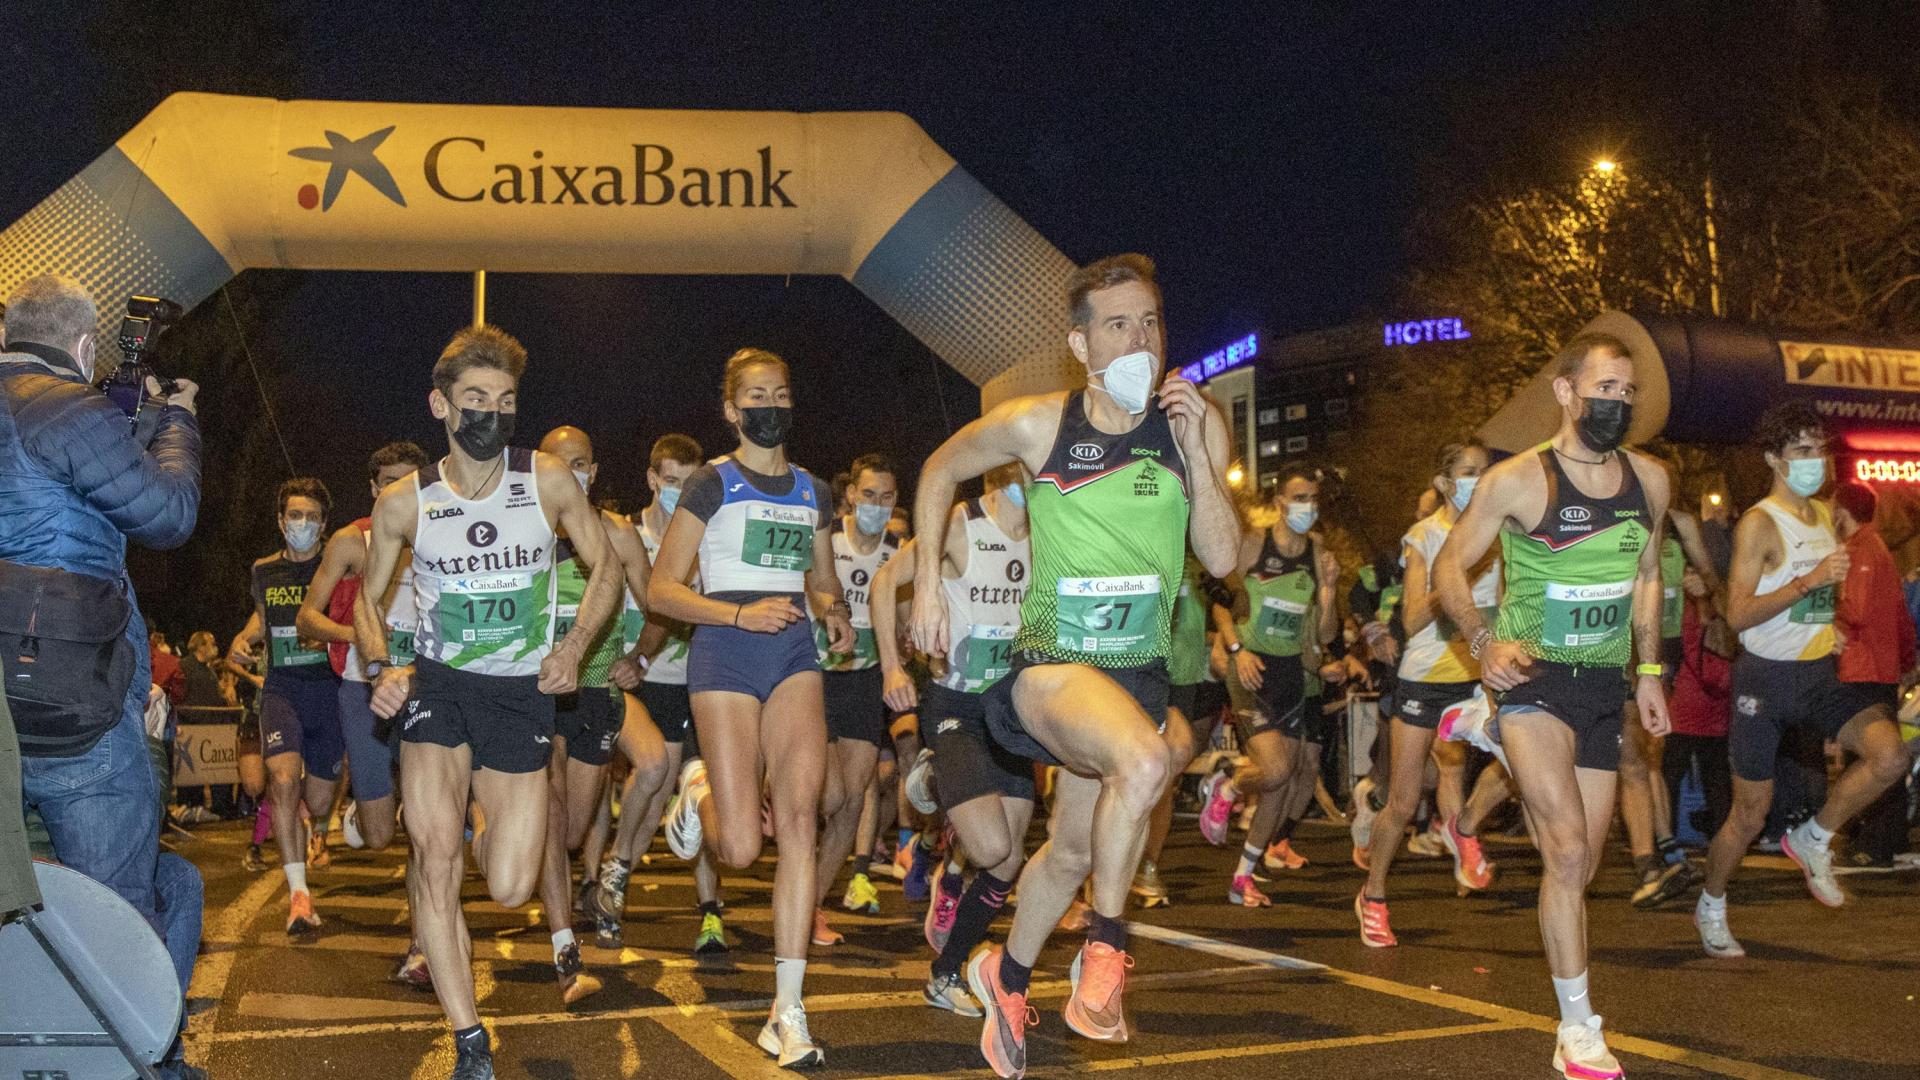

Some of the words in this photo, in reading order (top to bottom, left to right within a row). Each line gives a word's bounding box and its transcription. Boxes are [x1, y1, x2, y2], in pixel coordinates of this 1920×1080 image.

[422, 136, 799, 209] CaixaBank
[1383, 318, 1472, 346] HOTEL
[1068, 462, 1104, 470] Sakimóvil
[429, 507, 464, 520] LUGA
[766, 527, 804, 552] 172
[977, 543, 1007, 551] LUGA
[470, 577, 518, 590] CaixaBank
[1096, 581, 1145, 592] CaixaBank
[970, 584, 1026, 605] etxen
[1581, 586, 1624, 598] CaixaBank
[462, 598, 516, 624] 170
[1569, 604, 1618, 629] 100
[1272, 612, 1297, 629] 176
[283, 640, 303, 654] 14
